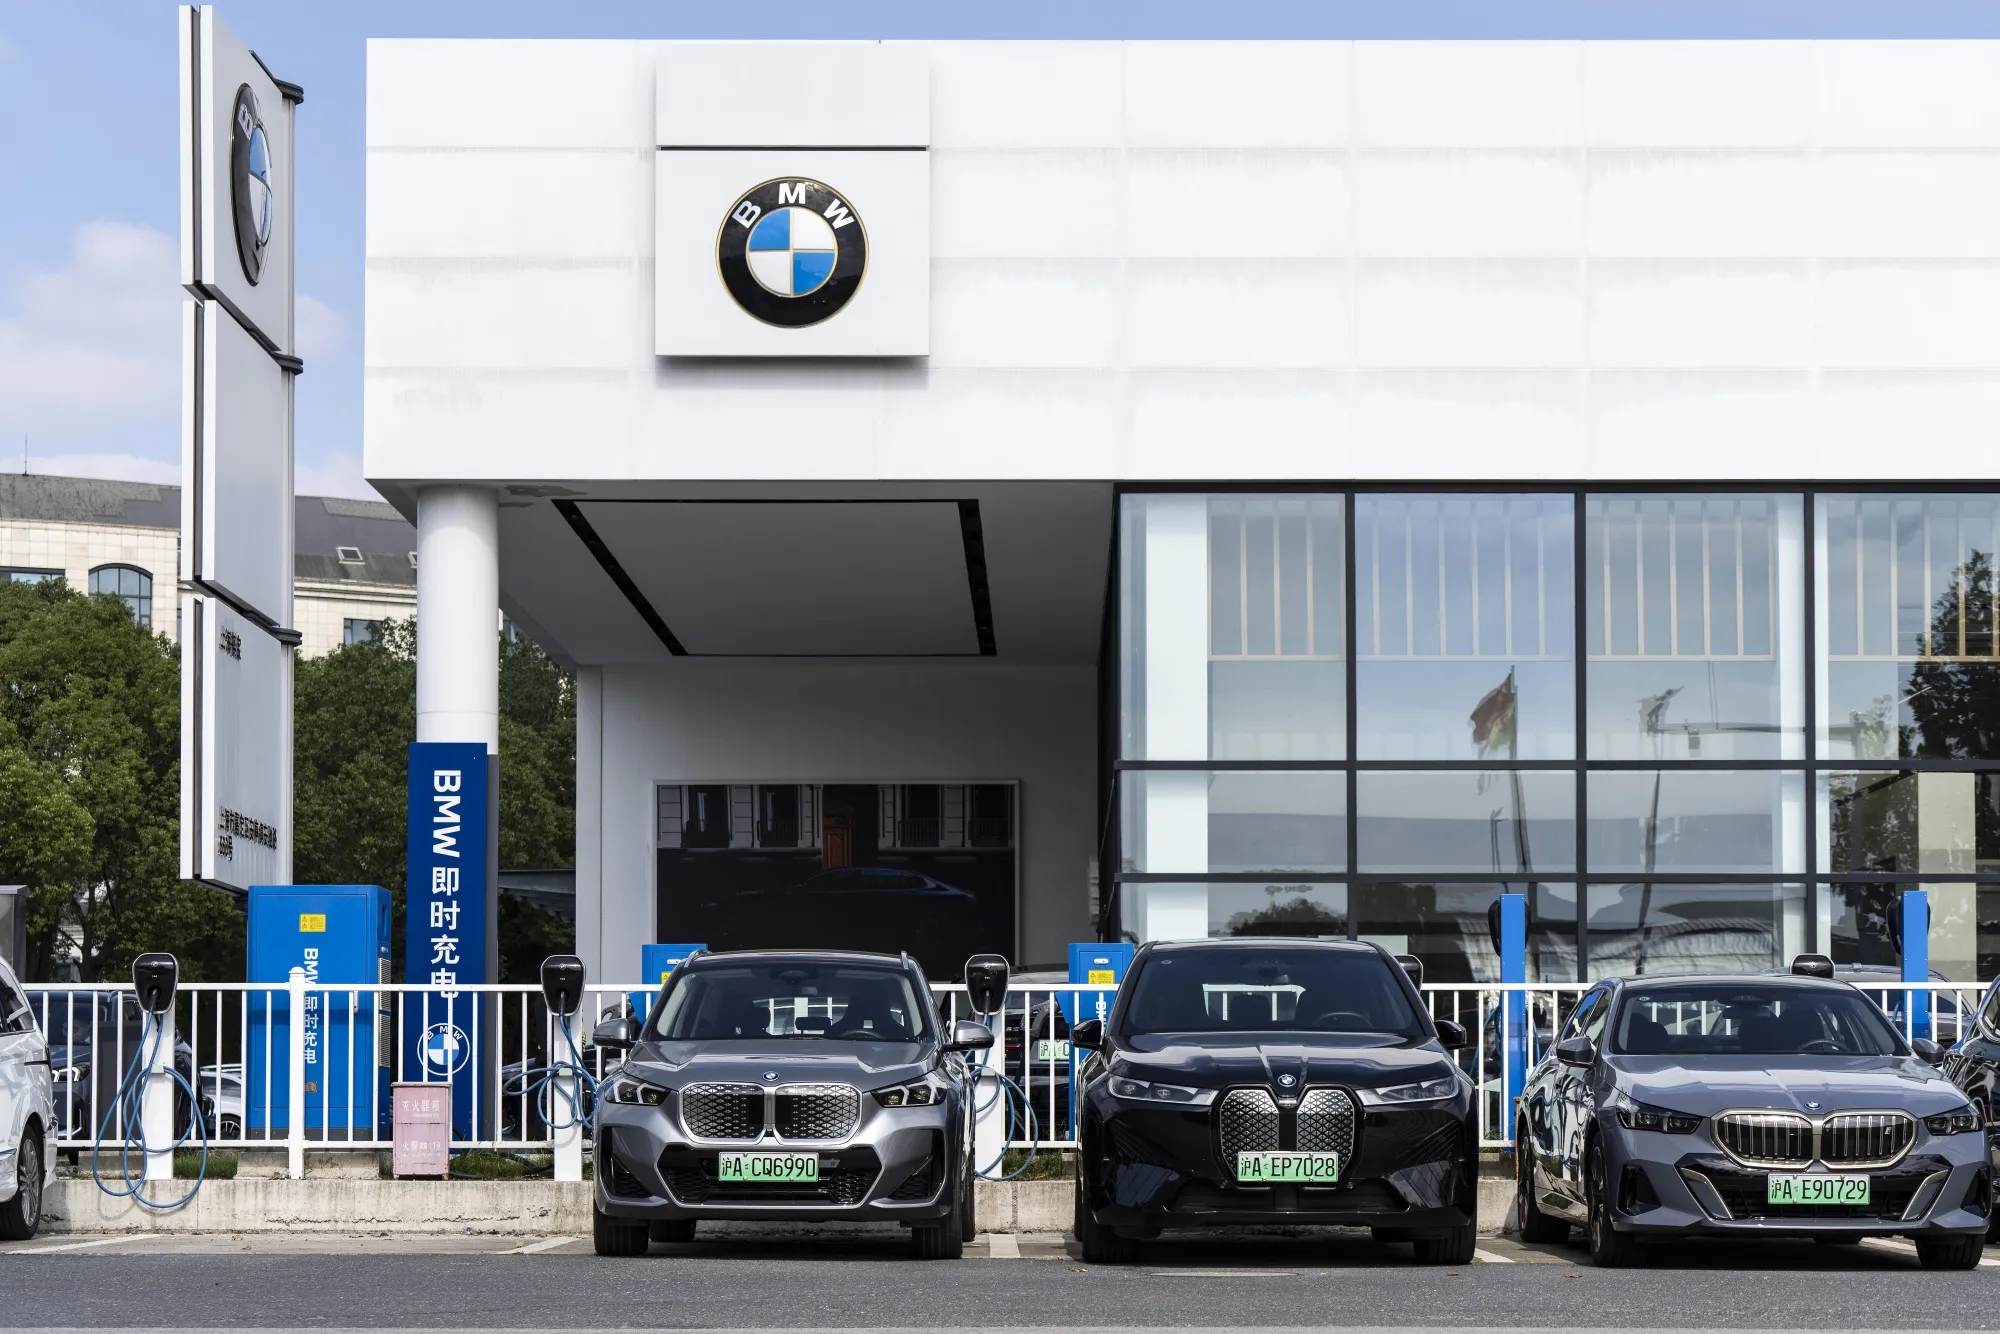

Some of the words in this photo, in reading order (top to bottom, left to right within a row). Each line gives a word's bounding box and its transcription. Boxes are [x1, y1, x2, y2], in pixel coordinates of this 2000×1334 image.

[732, 183, 855, 229] BMW
[433, 770, 461, 858] BMW
[430, 867, 460, 998] 即时充电
[402, 1100, 440, 1111] 灭火器箱
